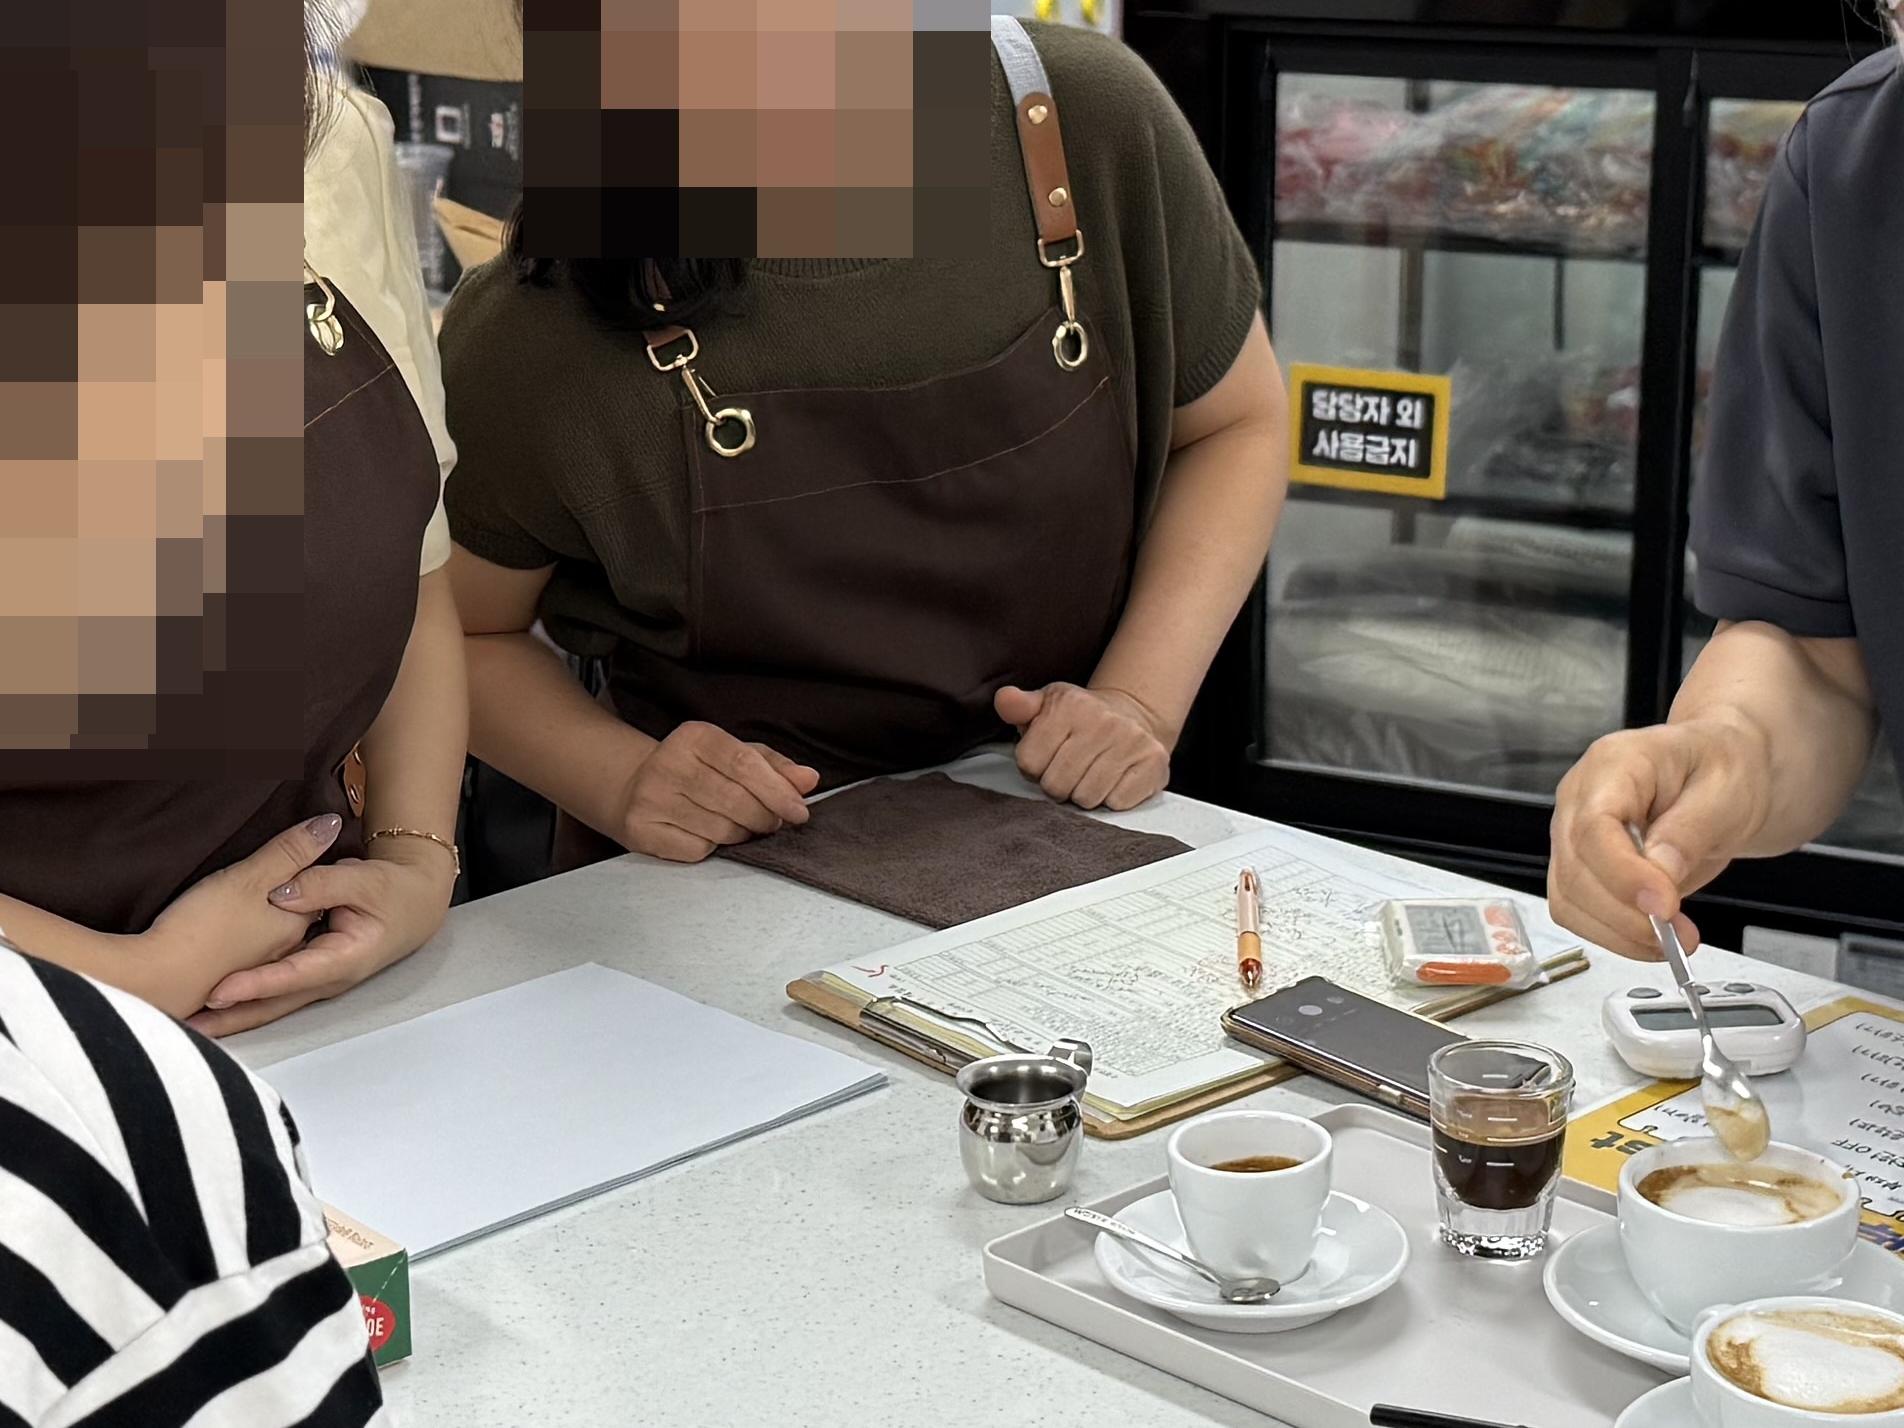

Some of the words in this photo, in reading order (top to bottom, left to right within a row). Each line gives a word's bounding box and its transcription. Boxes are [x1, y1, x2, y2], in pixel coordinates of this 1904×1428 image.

[1312, 390, 1391, 425] 담당자
[1396, 398, 1424, 429] 외
[1312, 429, 1417, 468] 사용금지
[1831, 1138, 1872, 1153] OFF
